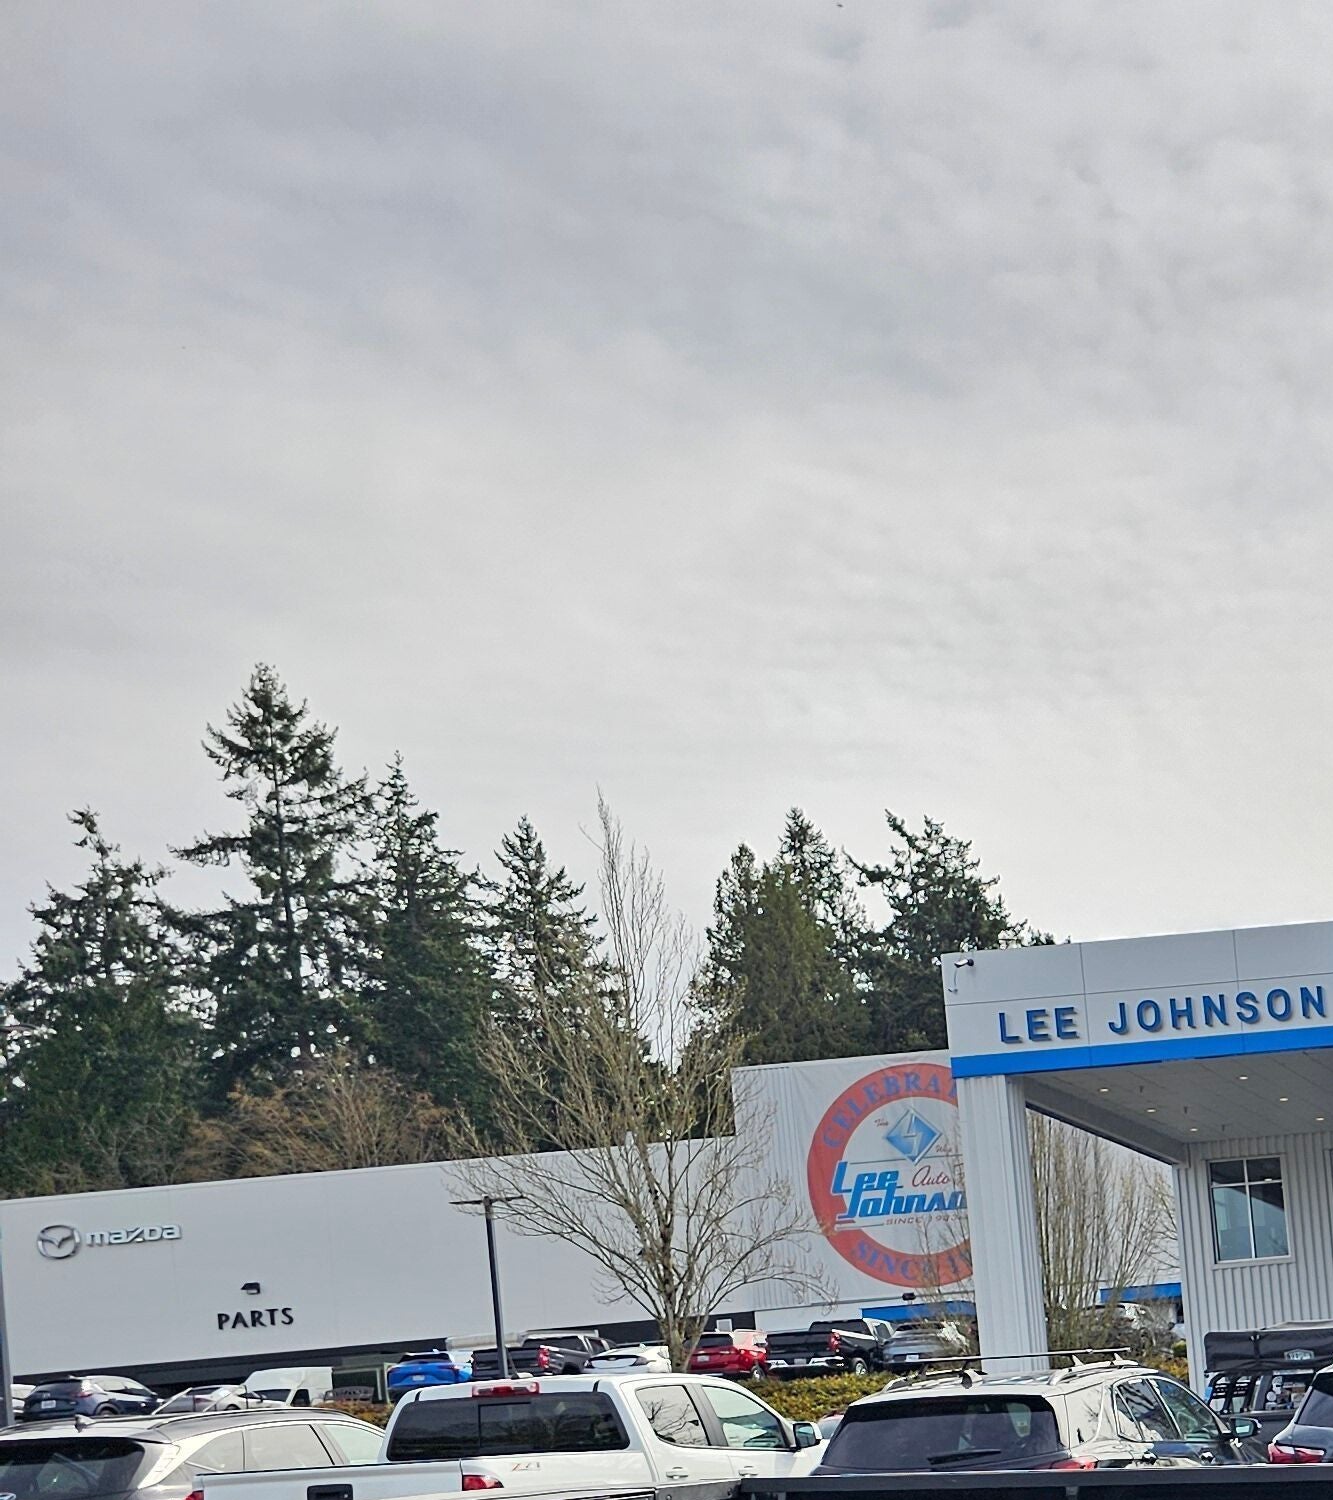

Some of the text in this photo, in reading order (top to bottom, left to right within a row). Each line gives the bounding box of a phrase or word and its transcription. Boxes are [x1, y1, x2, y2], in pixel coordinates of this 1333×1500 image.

[998, 985, 1327, 1044] LEE JOHNSON
[832, 1161, 900, 1194] Lee
[911, 1165, 951, 1188] Auto
[217, 1307, 294, 1330] PARTS
